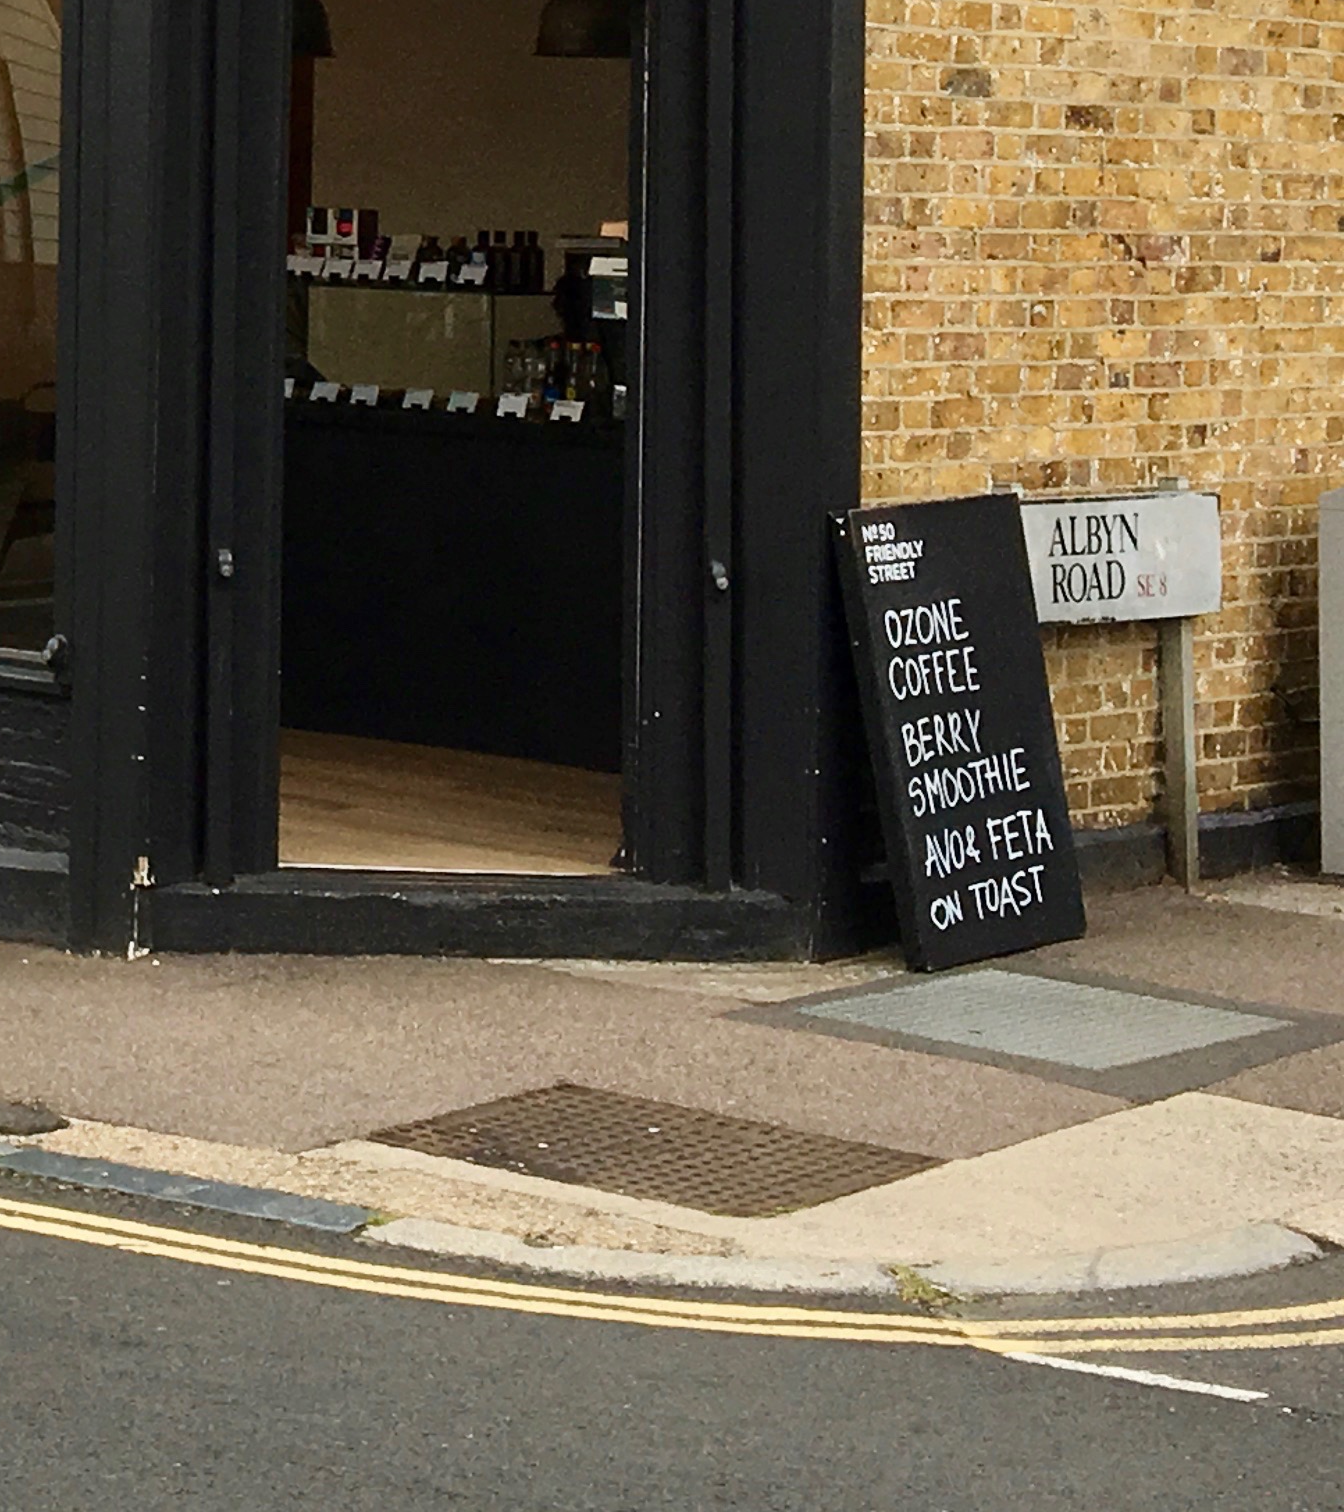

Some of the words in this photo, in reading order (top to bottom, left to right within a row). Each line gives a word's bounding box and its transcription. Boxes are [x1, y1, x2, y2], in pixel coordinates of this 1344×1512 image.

[865, 540, 923, 563] FRIENDLY
[1048, 513, 1139, 557] ALBYN
[868, 561, 915, 584] STREET
[1051, 560, 1126, 604] ROAD
[884, 598, 969, 648] OZONE
[888, 646, 980, 700] COFFEE
[901, 708, 981, 767] BERRY
[908, 748, 1030, 817] SMOOTHIE
[986, 808, 1054, 860] FETA
[930, 890, 963, 930] ON
[968, 865, 1044, 920] TOAST
